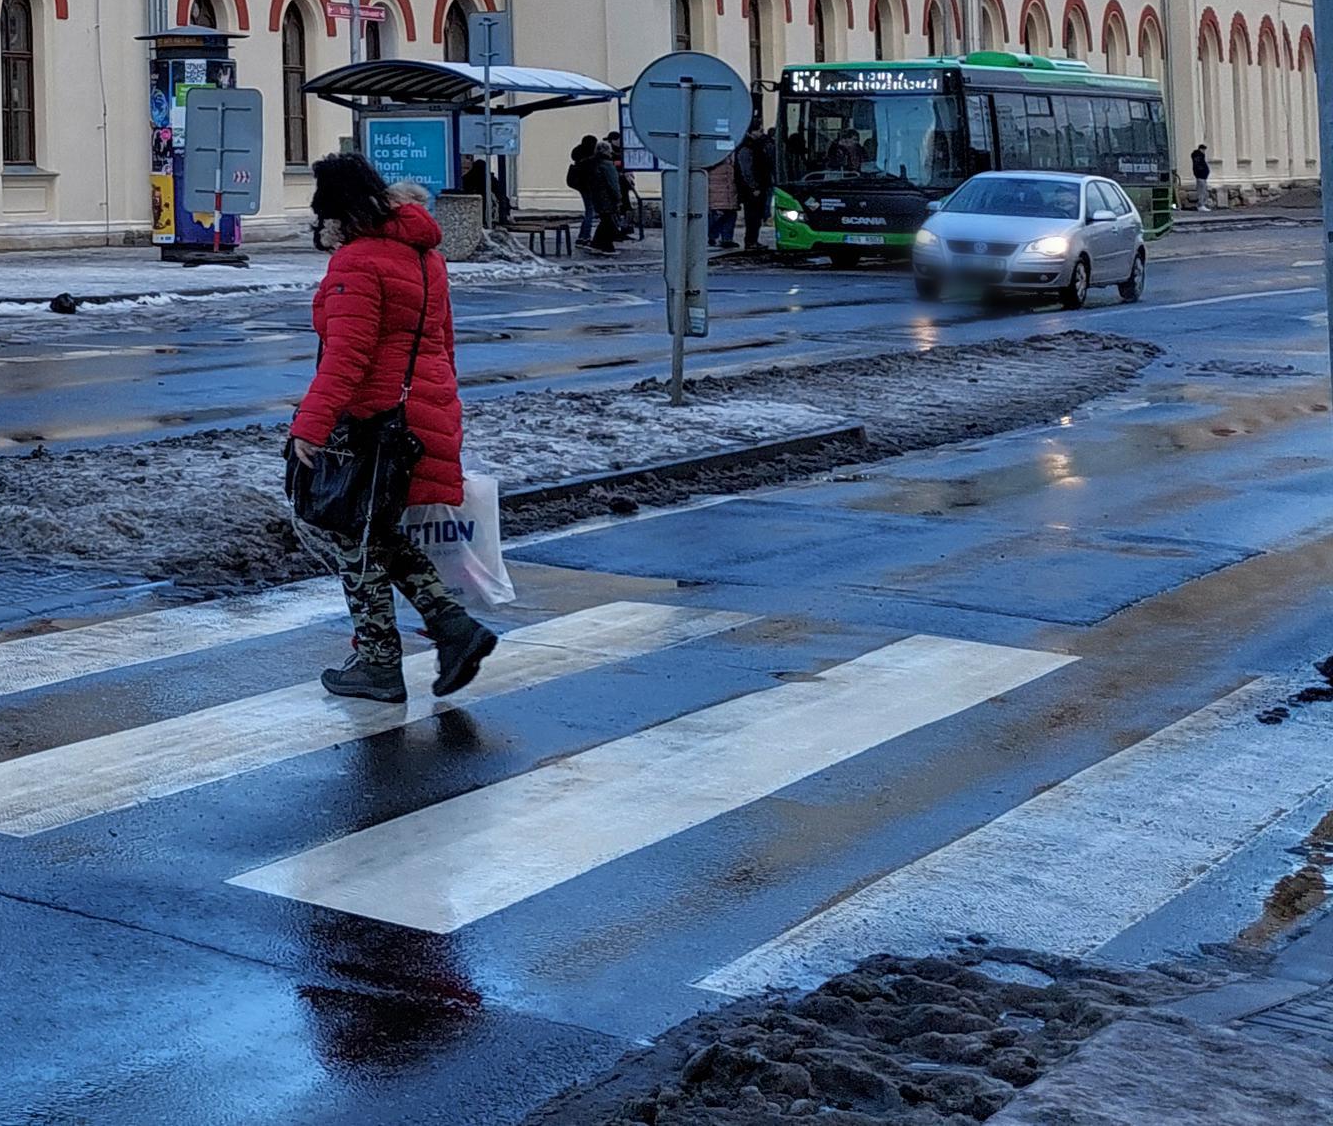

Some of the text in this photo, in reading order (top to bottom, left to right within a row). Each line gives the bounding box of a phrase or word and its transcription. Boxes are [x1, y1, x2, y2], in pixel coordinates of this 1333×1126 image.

[374, 133, 415, 148] Hádej,
[374, 146, 427, 158] co se mi
[374, 160, 405, 172] honí
[841, 217, 887, 225] SCANIA
